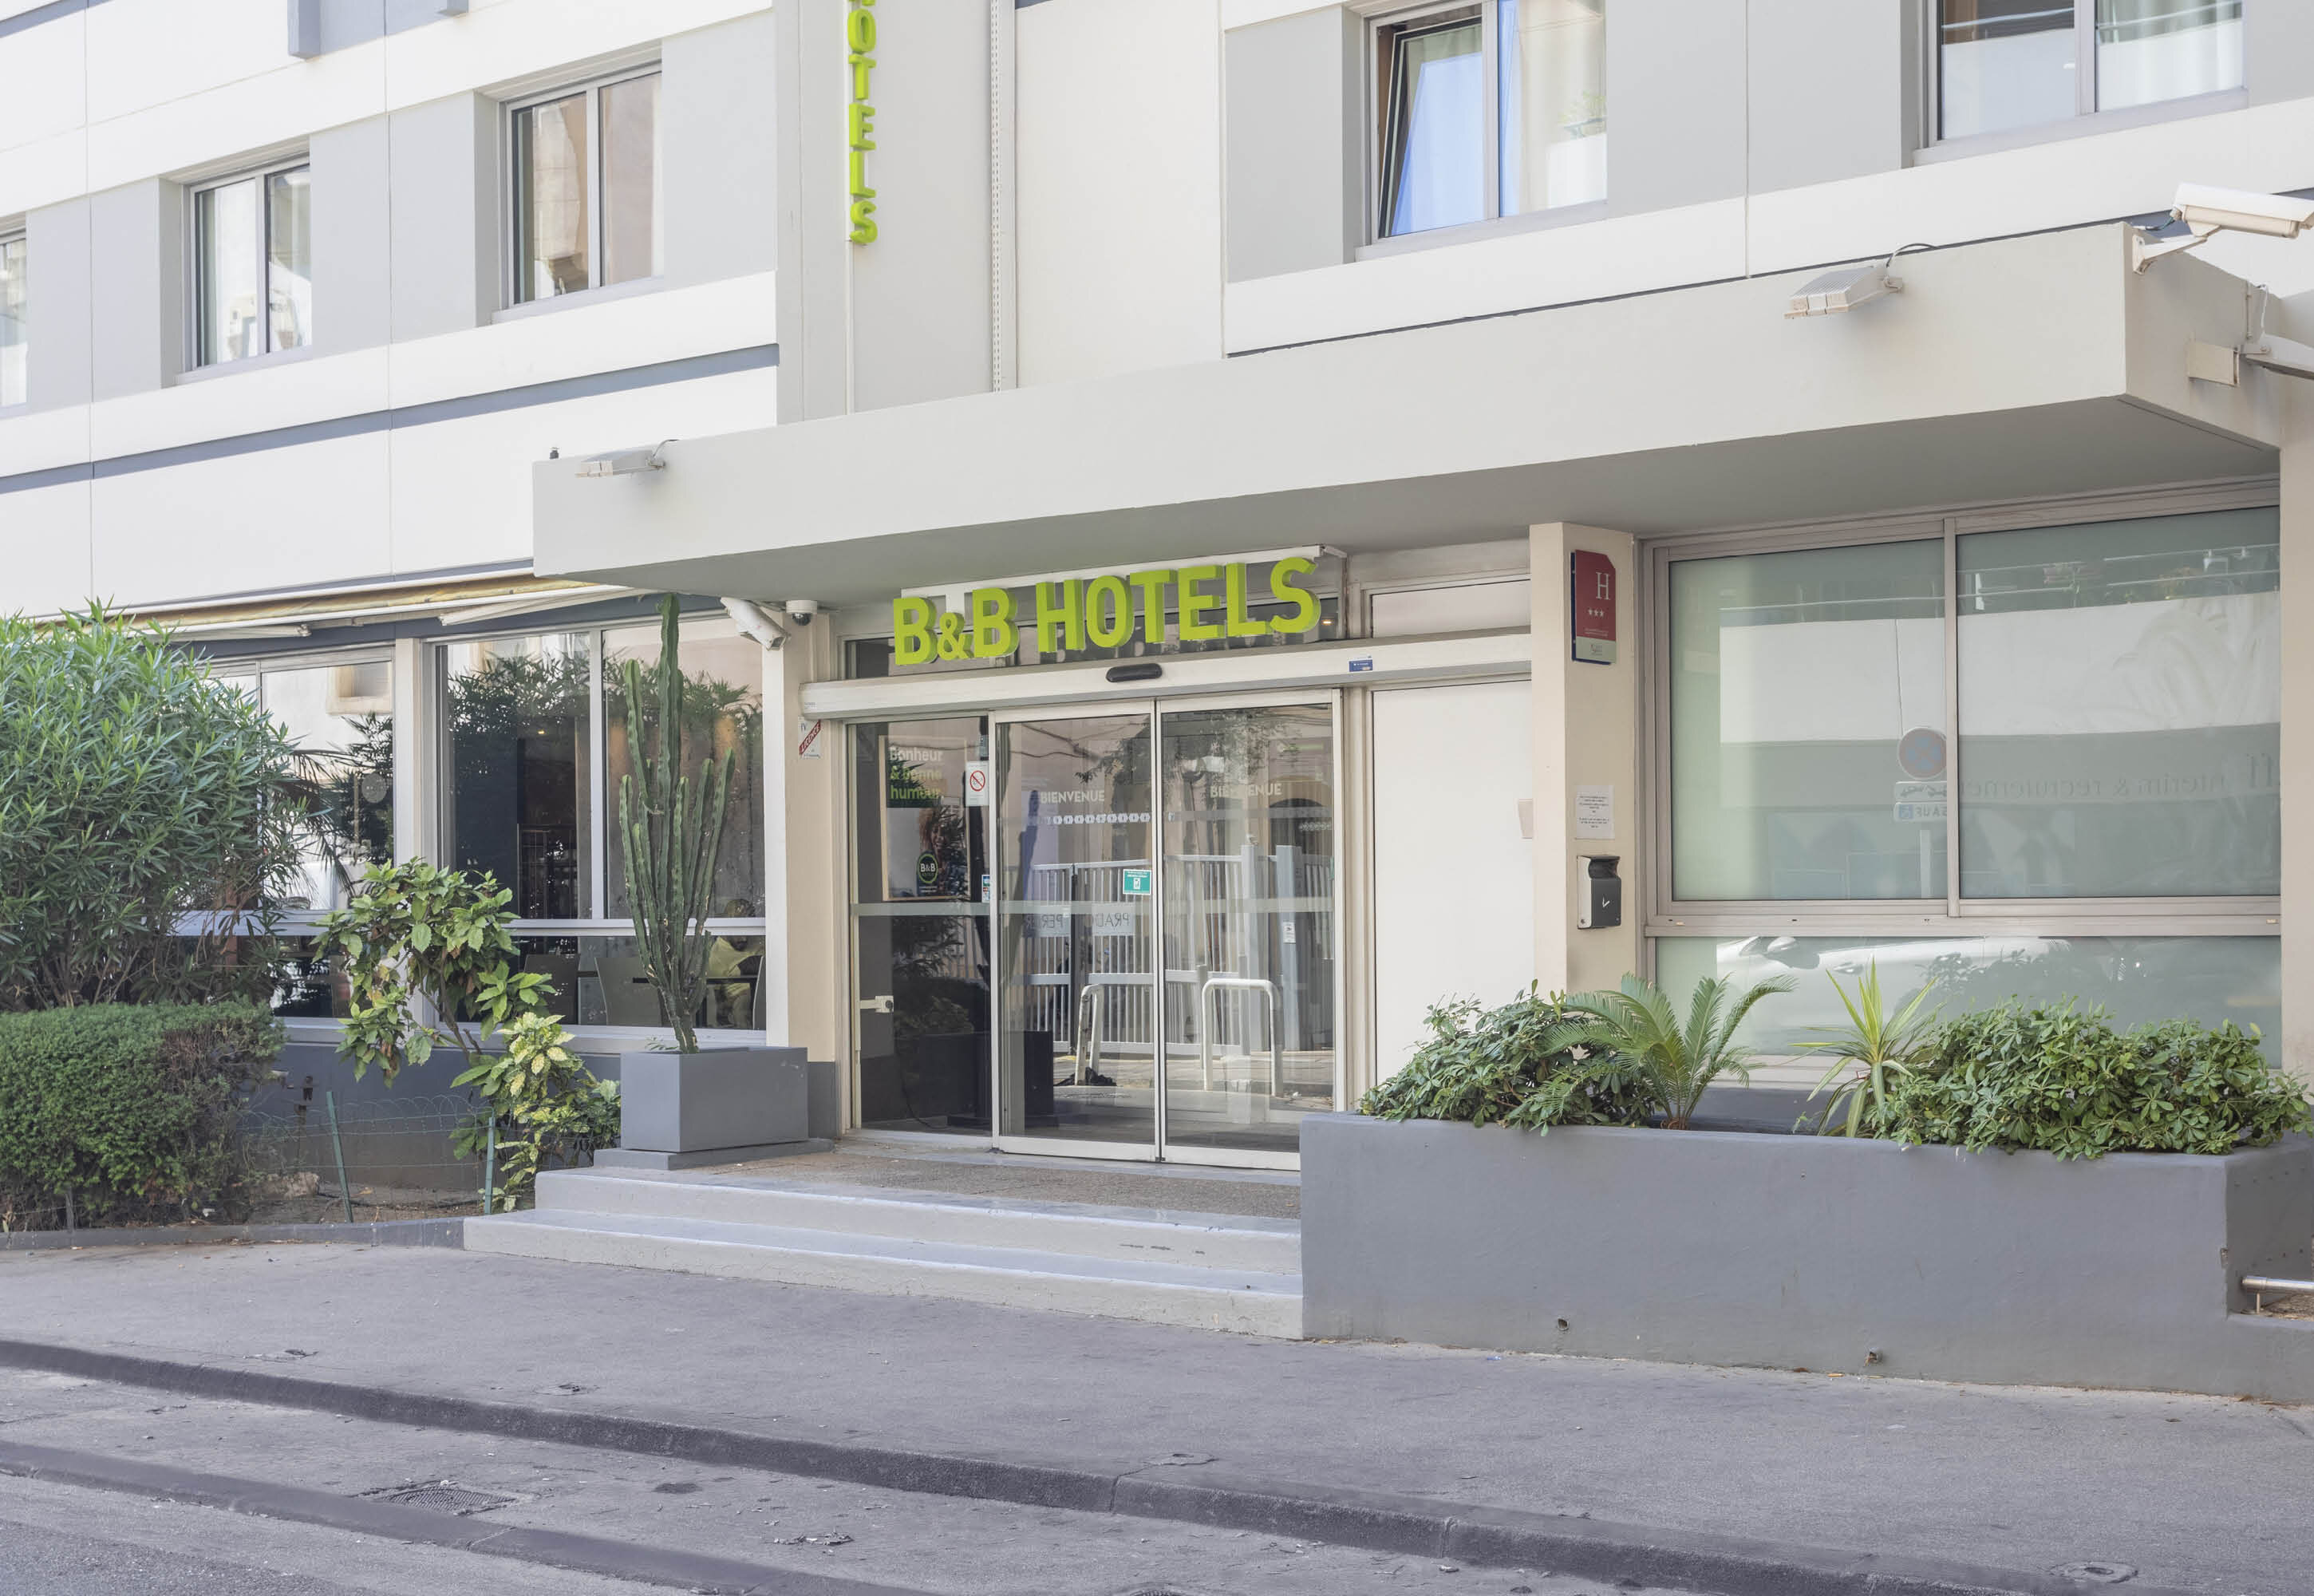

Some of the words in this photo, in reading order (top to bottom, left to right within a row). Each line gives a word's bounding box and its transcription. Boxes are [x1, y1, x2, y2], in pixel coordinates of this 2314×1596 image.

[847, 0, 878, 244] OTELS
[1595, 571, 1610, 600] H
[893, 587, 1019, 665] B&B
[1036, 556, 1321, 653] HOTELS
[890, 746, 944, 761] Bonheur
[1040, 790, 1105, 804] BIENVENUE
